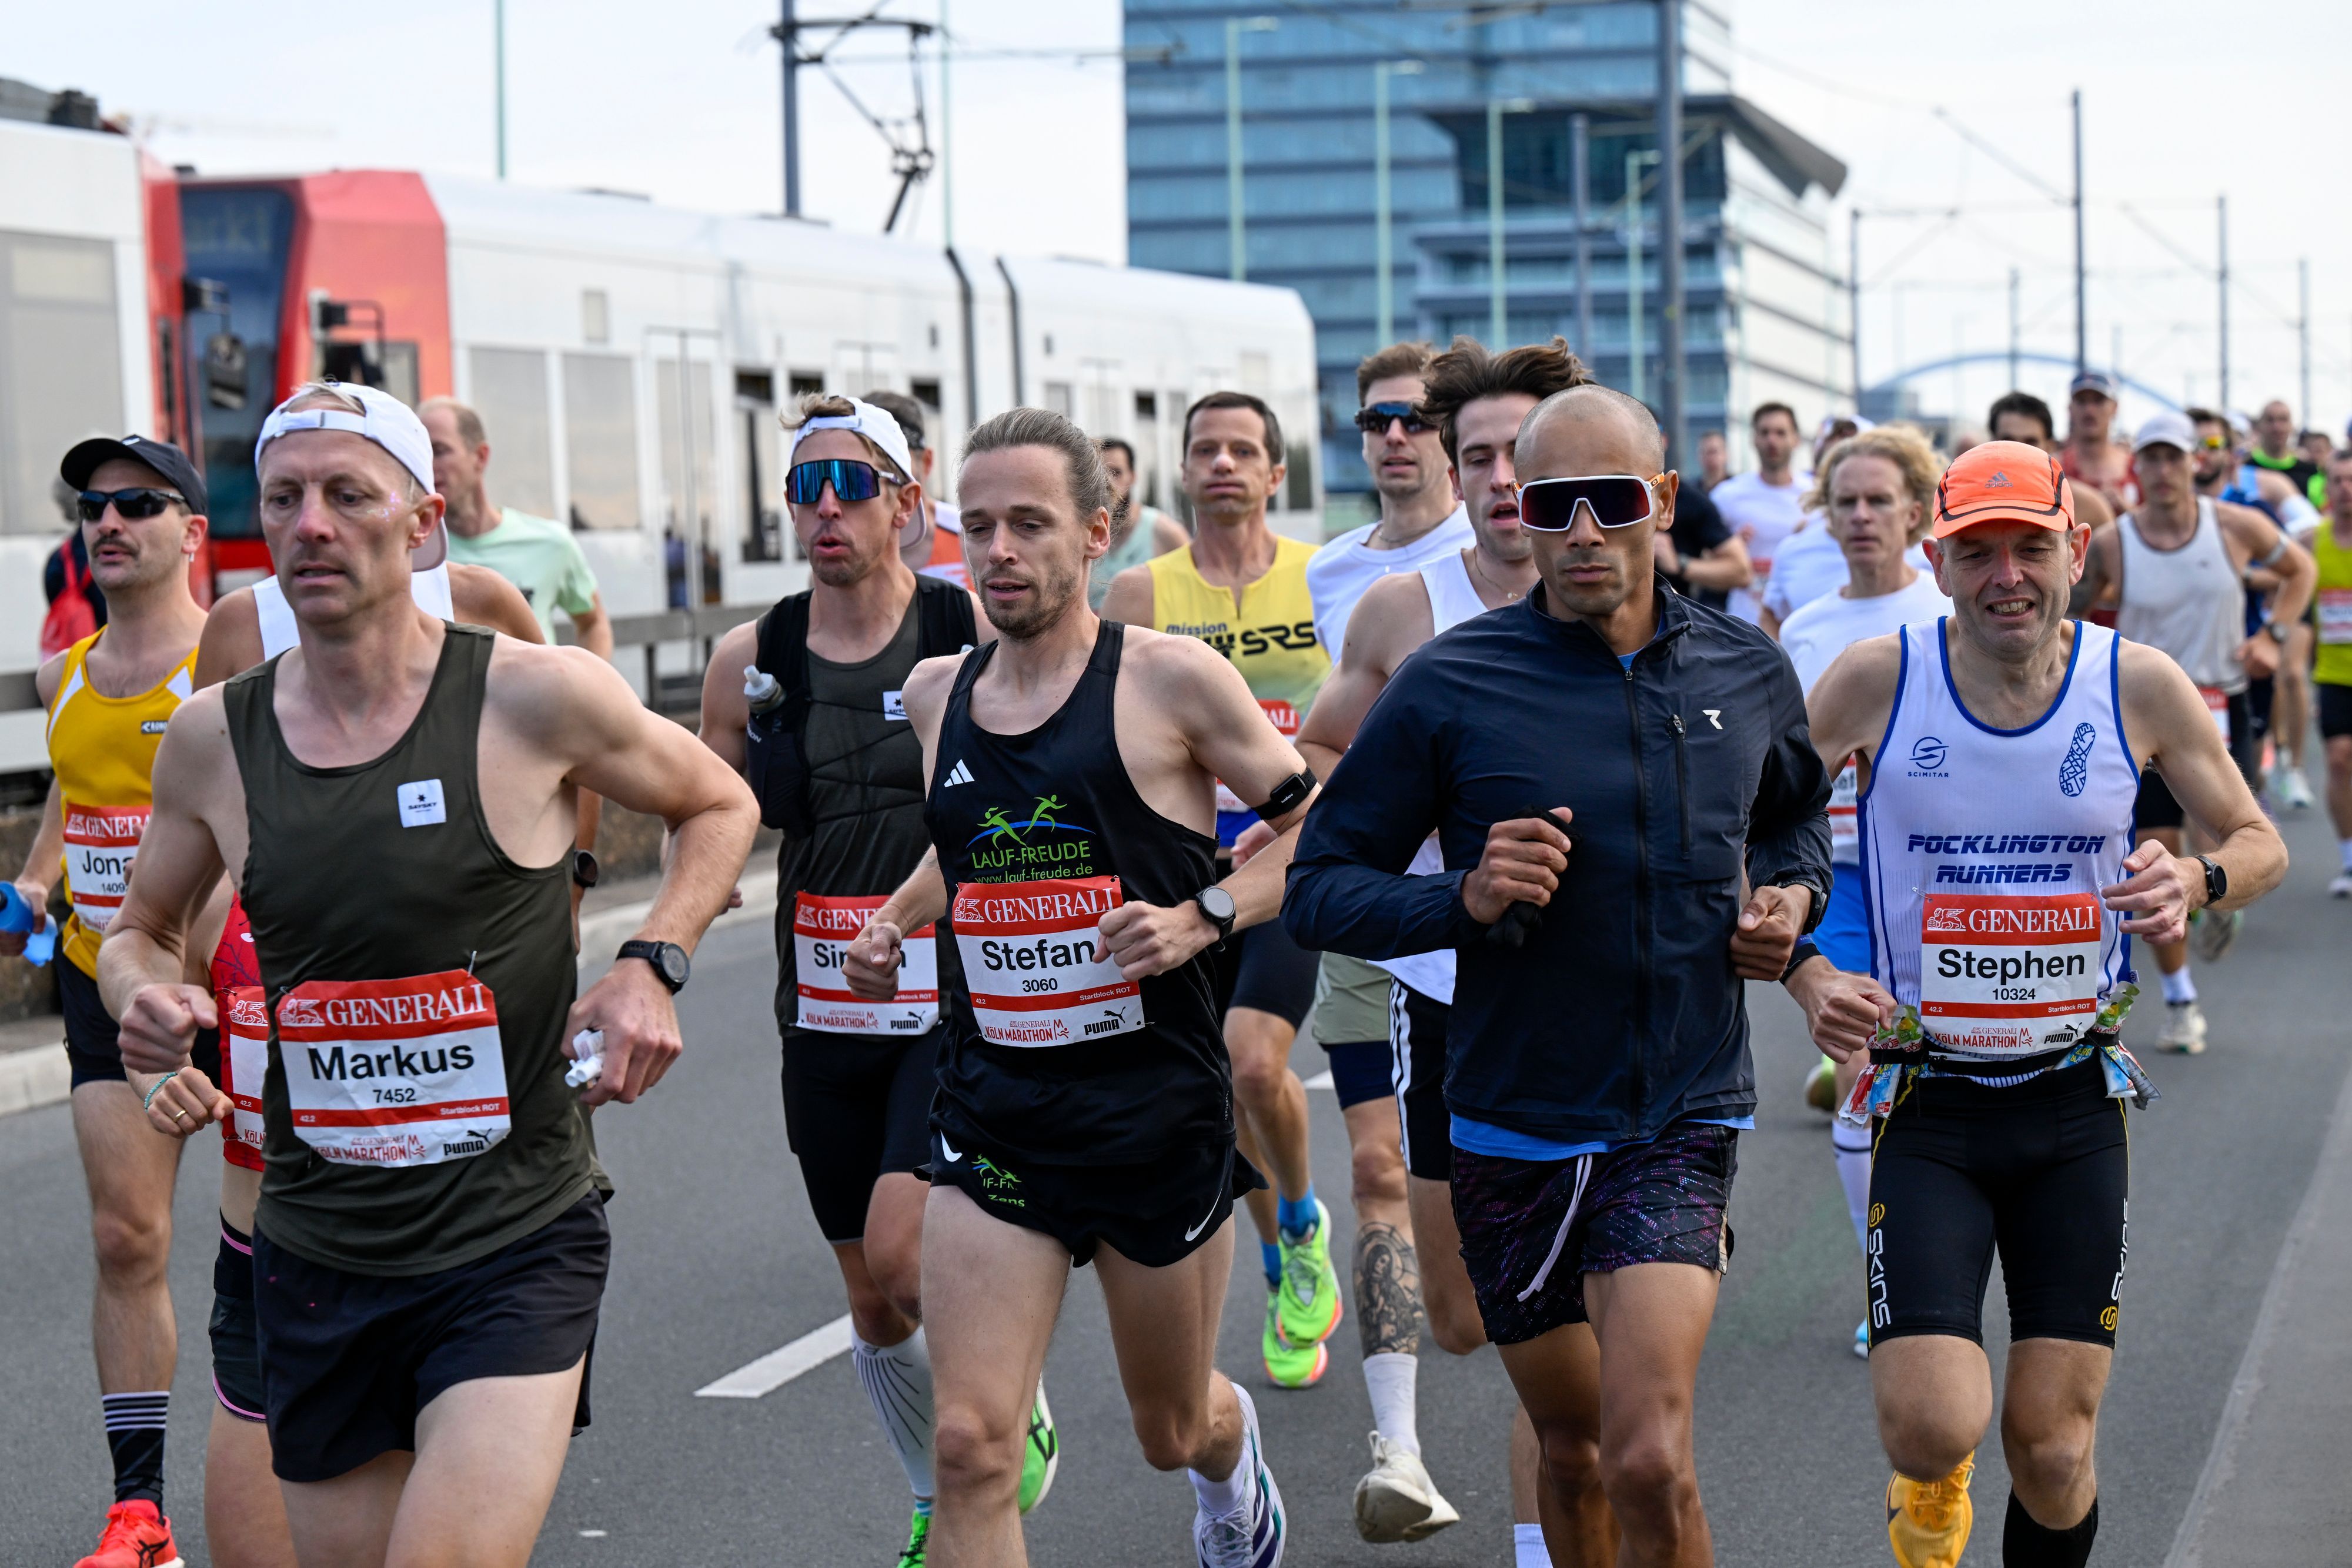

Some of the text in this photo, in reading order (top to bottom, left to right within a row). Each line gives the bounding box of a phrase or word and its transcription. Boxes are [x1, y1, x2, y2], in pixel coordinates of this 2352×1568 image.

[1167, 622, 1227, 636] mission
[1241, 621, 1317, 657] SRS
[1907, 834, 2106, 854] POCKLINGTON
[972, 840, 1091, 869] LAUF-FREUDE
[975, 862, 1093, 884] www.lauf-freude.de
[1935, 863, 2073, 884] RUNNERS
[102, 882, 129, 894] 1409
[984, 887, 1116, 924] GENERALI
[1969, 906, 2096, 933] GENERALI
[981, 938, 1094, 971] Stefan
[1937, 948, 2084, 985] Stephen
[1022, 978, 1058, 993] 3060
[1080, 986, 1131, 1001] Startblock ROT
[1992, 988, 2036, 1001] 10324
[326, 982, 487, 1027] GENERALI
[2048, 1004, 2076, 1013] Startblock
[823, 1015, 866, 1028] MARATHON
[890, 1020, 919, 1029] PUMA
[1017, 1019, 1051, 1028] GENERALI
[1084, 1018, 1120, 1035] PUMA
[985, 1025, 1054, 1042] KÖLN MARATHON
[1935, 1032, 2017, 1048] KÖLN MARATHON
[2044, 1033, 2073, 1044] PUMA
[307, 1045, 475, 1081] Markus
[373, 1088, 417, 1104] 7452
[440, 1103, 500, 1115] Startblock ROT
[300, 1114, 316, 1122] 42.2
[342, 1145, 407, 1162] MARATHON
[444, 1140, 485, 1156] PUMA
[1869, 1228, 1891, 1329] SKINS
